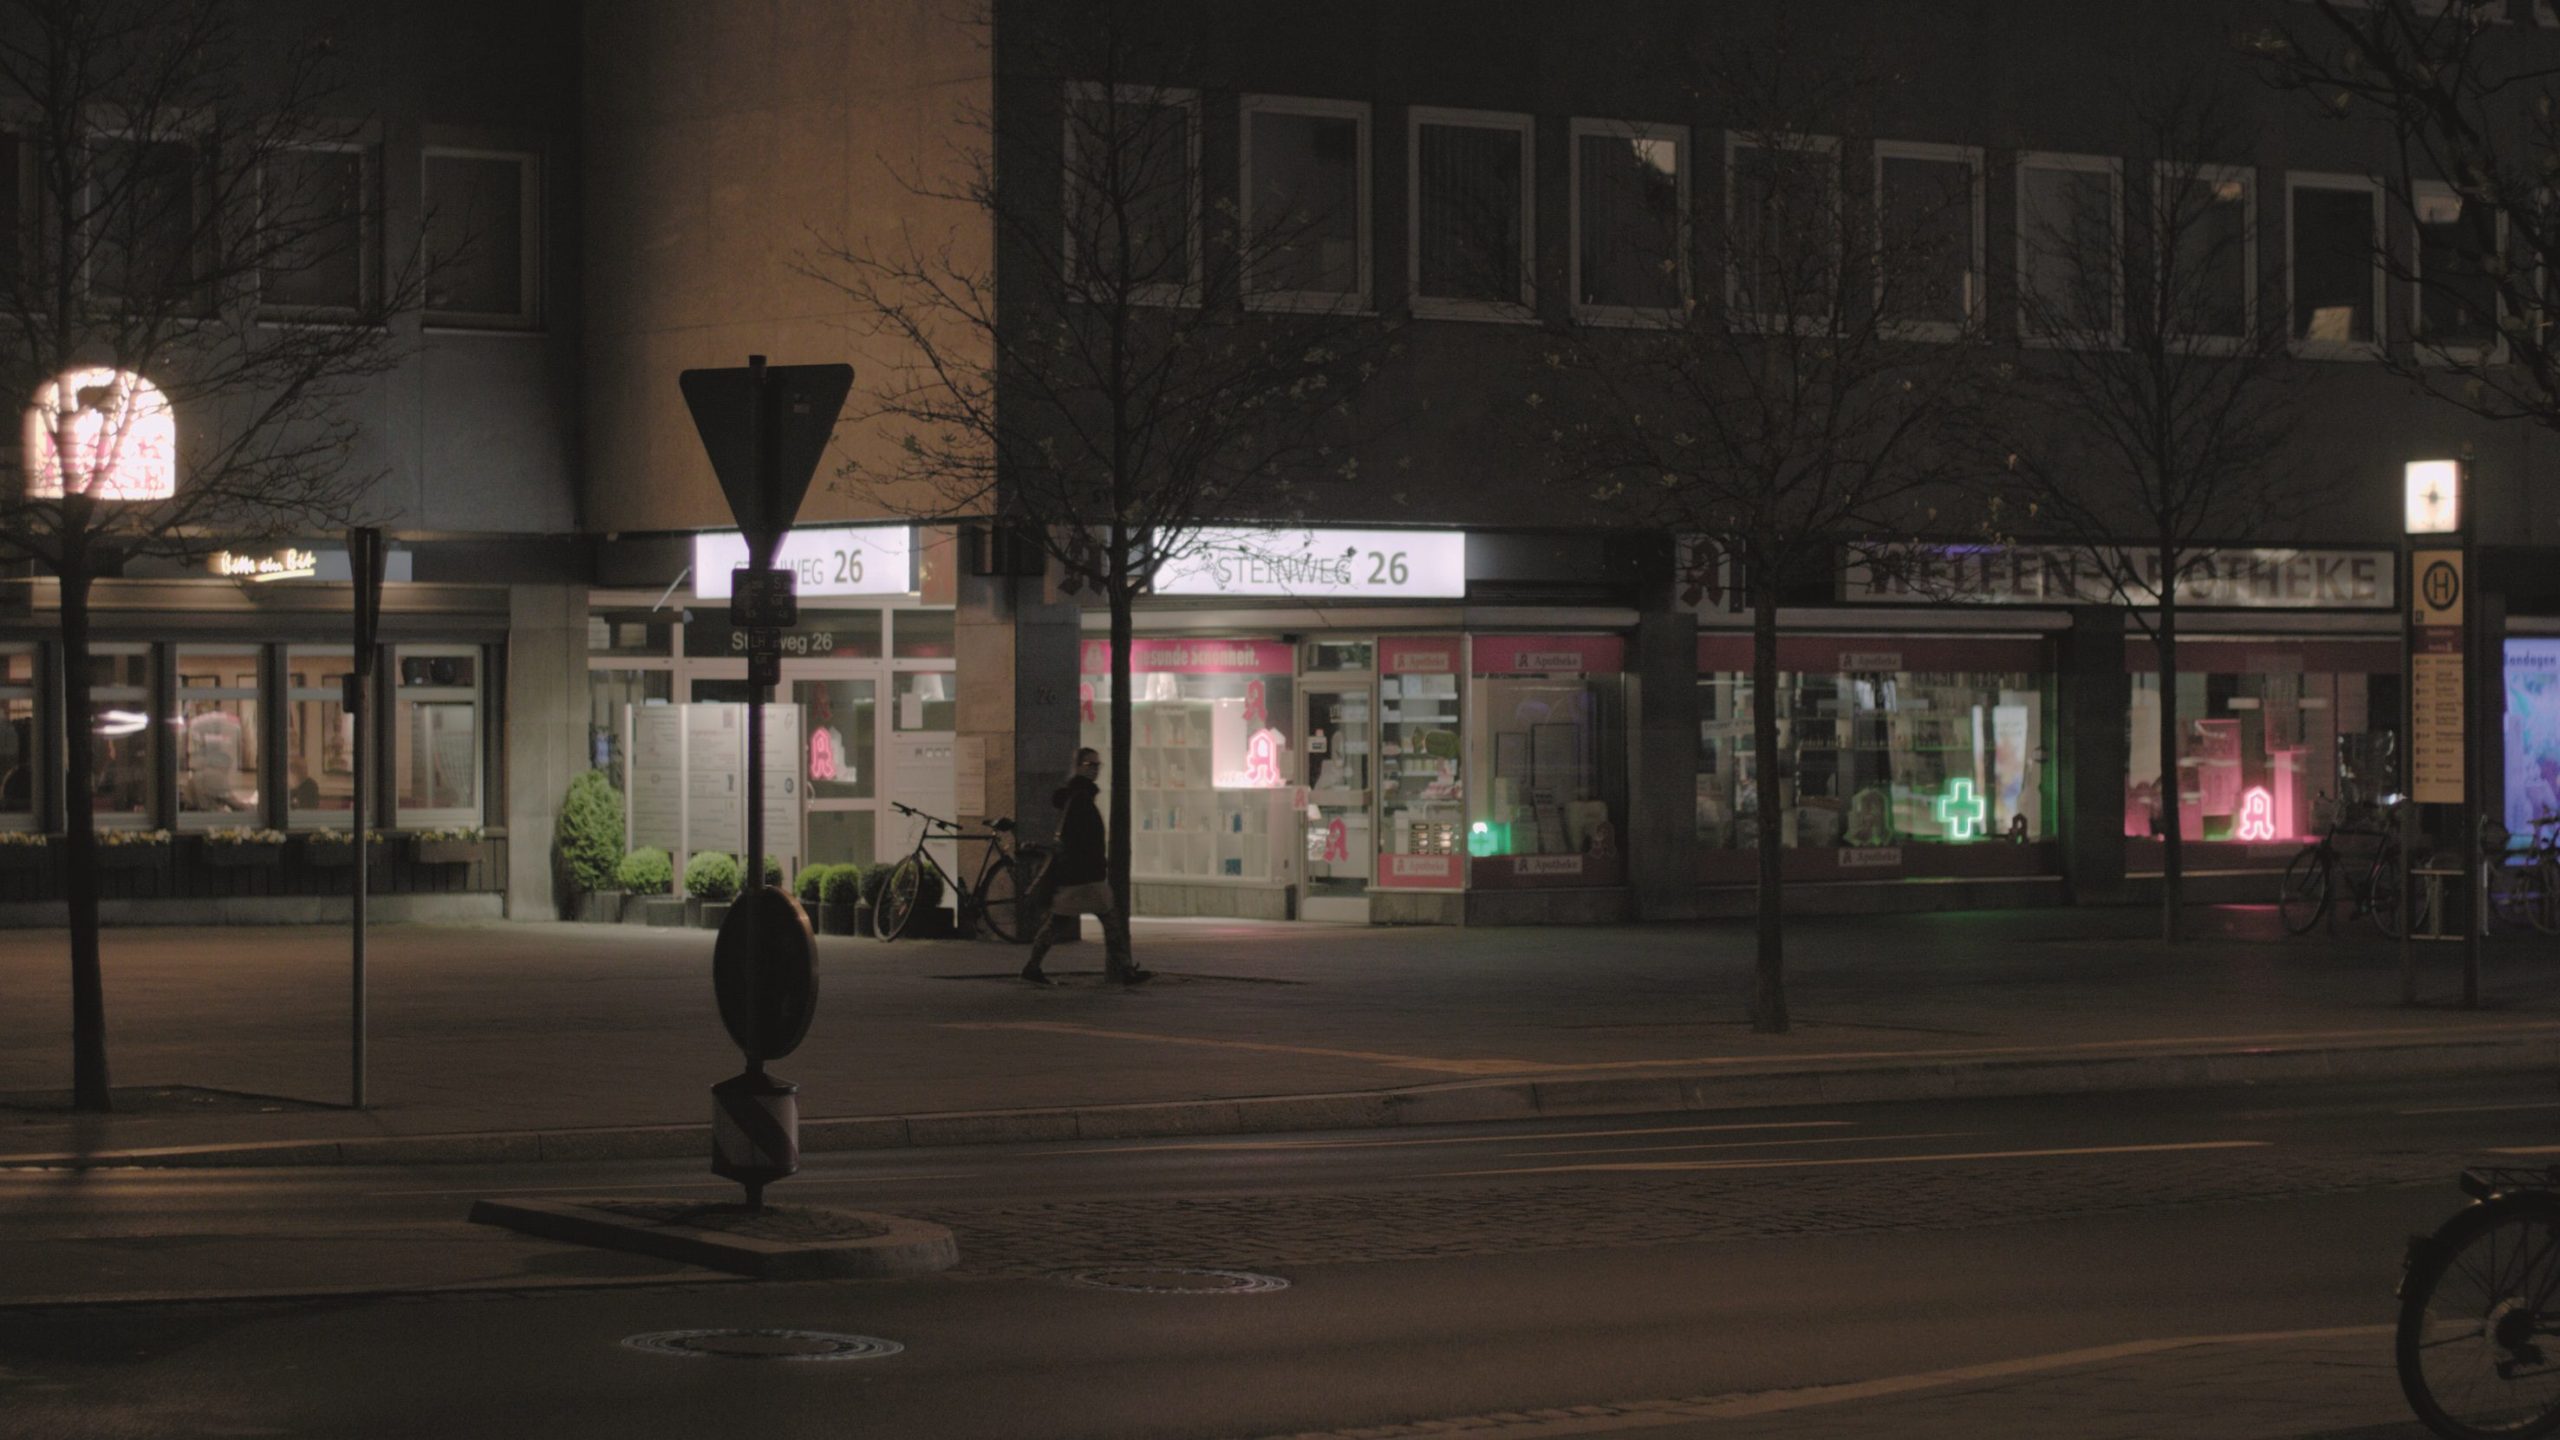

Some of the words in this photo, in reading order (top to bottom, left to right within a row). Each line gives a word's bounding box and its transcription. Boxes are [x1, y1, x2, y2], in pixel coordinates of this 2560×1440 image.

[833, 549, 863, 584] 26
[1217, 556, 1352, 585] STEINWEG
[1366, 551, 1410, 585] 26
[2432, 572, 2450, 600] H
[811, 631, 833, 651] 26
[1534, 654, 1578, 668] Apotheke
